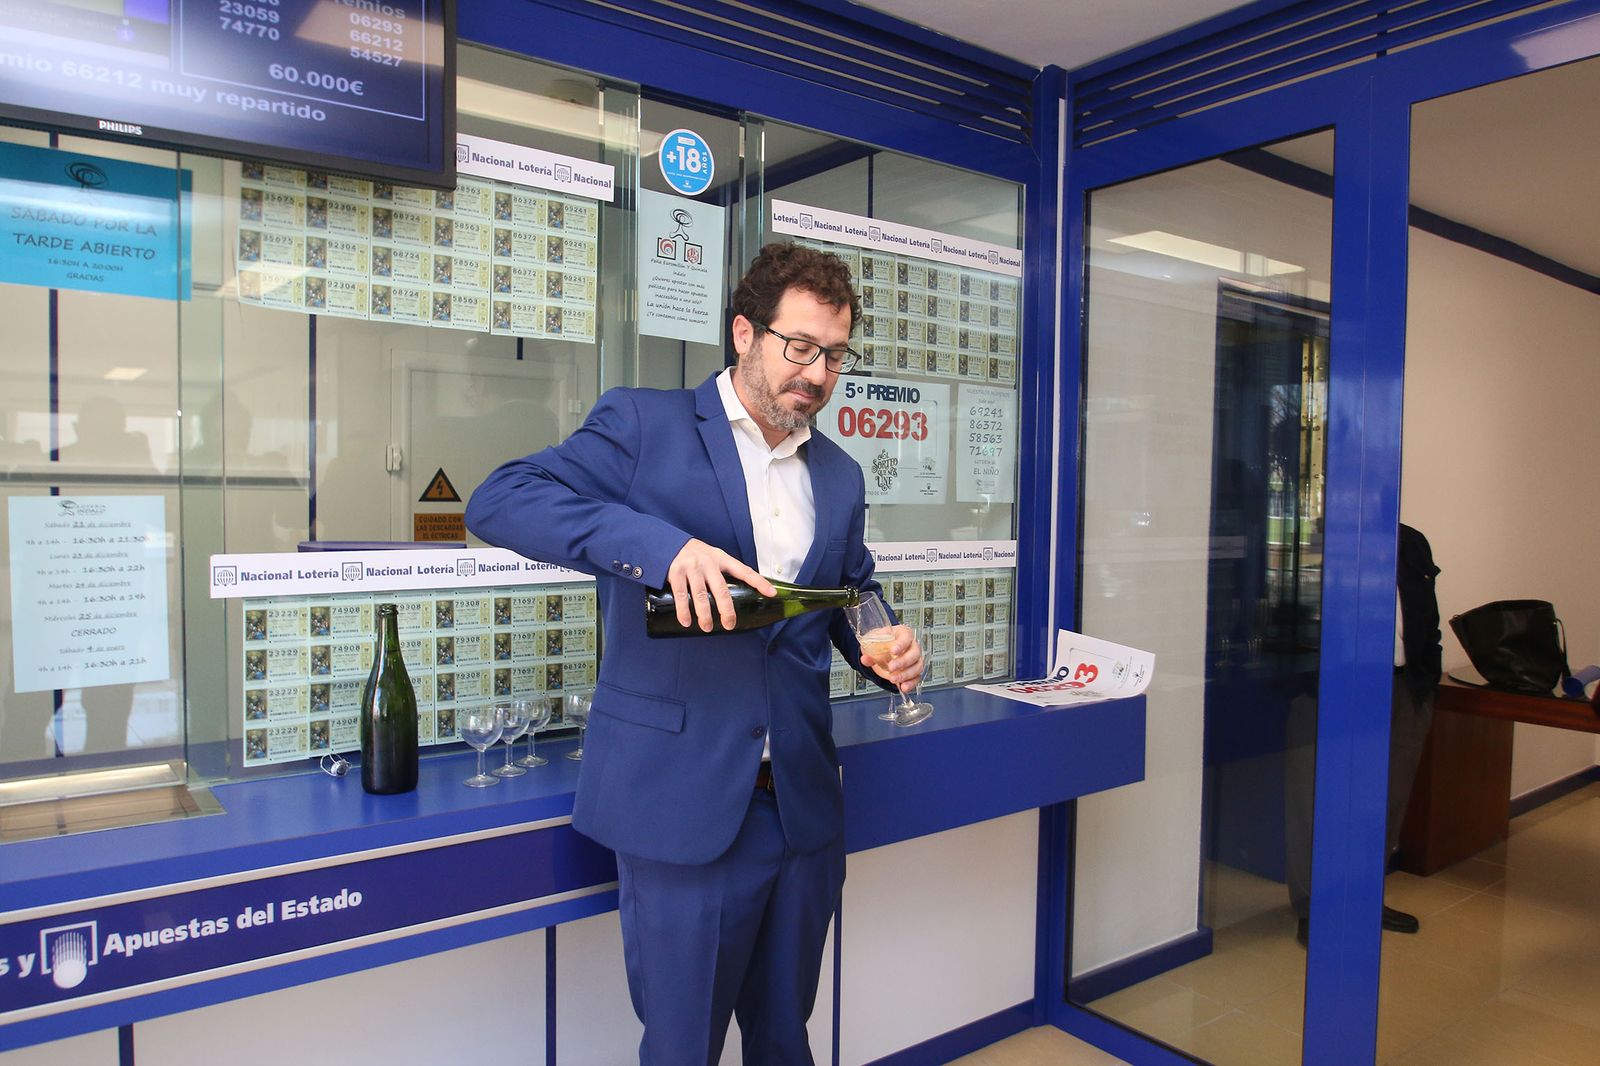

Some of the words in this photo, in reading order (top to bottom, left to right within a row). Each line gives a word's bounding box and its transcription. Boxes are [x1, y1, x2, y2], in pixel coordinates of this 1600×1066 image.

[219, 1, 280, 24] 23059
[219, 16, 280, 41] 74770
[349, 12, 404, 35] 06293
[349, 30, 404, 51] 66212
[349, 46, 404, 68] 54527
[269, 63, 365, 96] 60.000€
[62, 60, 143, 89] 66212
[151, 79, 207, 103] muy
[216, 90, 327, 122] repartido
[98, 119, 143, 136] PHILIPS
[666, 145, 702, 173] +18
[472, 152, 514, 169] Nacional
[574, 173, 612, 189] Nacional
[93, 219, 129, 232] POR
[135, 223, 157, 237] LA
[13, 233, 74, 250] TARDE
[80, 241, 156, 260] ABIERTO
[814, 220, 843, 233] Nacional
[882, 232, 908, 245] Nacional
[943, 245, 967, 256] Nacional
[999, 256, 1021, 267] Nacional
[692, 308, 709, 316] fuerza
[866, 383, 921, 404] PREMIO
[970, 406, 1003, 418] 69241
[837, 405, 929, 442] 06293
[969, 419, 1003, 431] 86372
[969, 432, 1002, 444] 58563
[969, 445, 1003, 457] 71697
[973, 467, 981, 475] EL
[983, 466, 999, 476] NIÑO
[877, 554, 903, 562] Nacional
[938, 551, 962, 560] Nacional
[993, 550, 1015, 558] Nacional
[240, 569, 293, 582] Nacional
[297, 567, 339, 580] Lotería
[366, 565, 412, 577] Nacional
[417, 564, 454, 575] Lotería
[478, 562, 520, 573] Nacional
[397, 603, 421, 611] 9308
[71, 627, 117, 637] CERRADO
[18, 951, 36, 979] y
[103, 916, 230, 957] Apuestas
[236, 902, 275, 930] del
[281, 889, 363, 921] Estado
